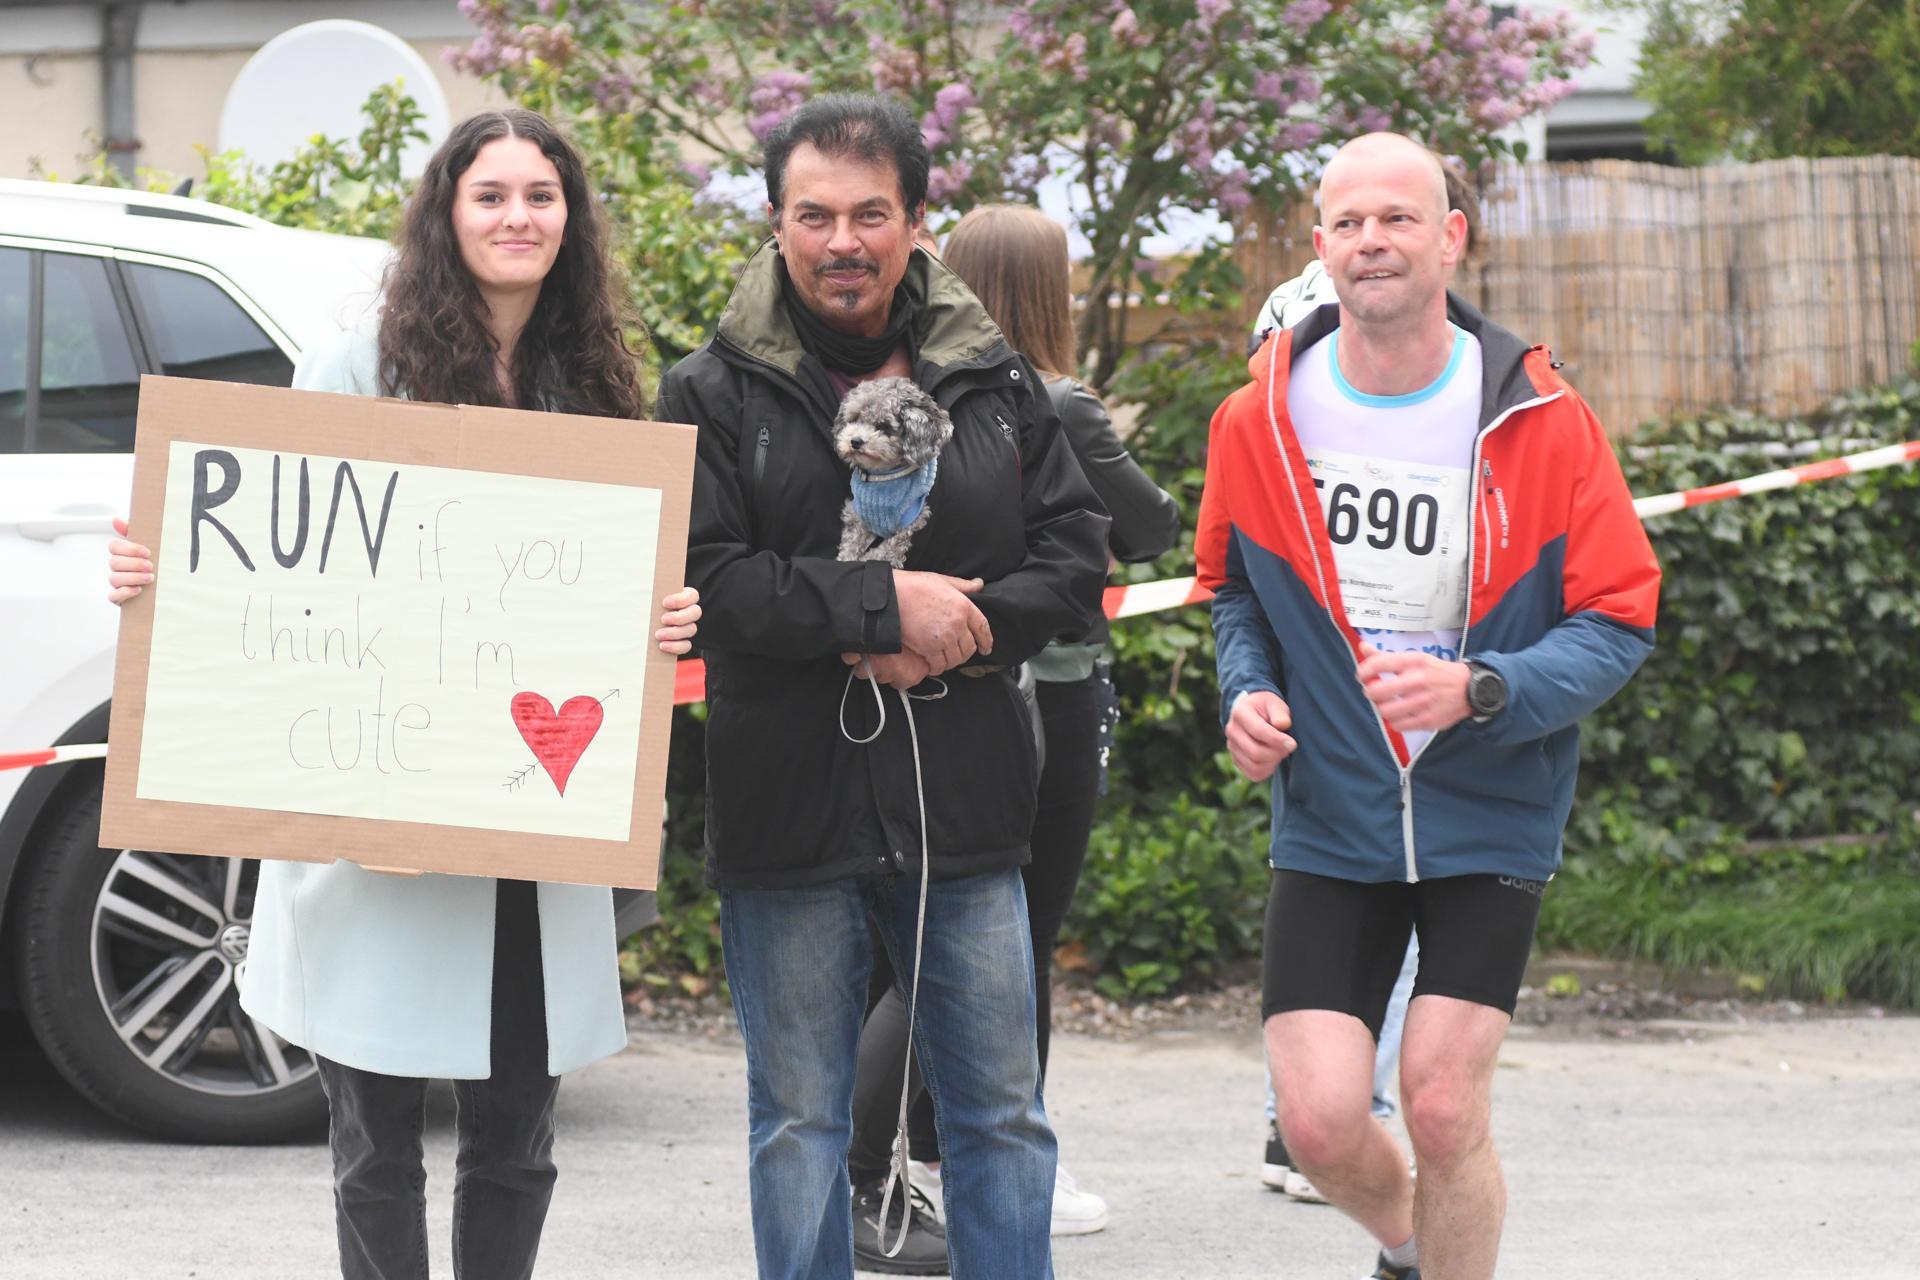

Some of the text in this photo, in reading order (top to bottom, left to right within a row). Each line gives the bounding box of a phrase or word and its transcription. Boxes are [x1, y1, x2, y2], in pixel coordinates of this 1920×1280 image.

[190, 449, 583, 611] RUN if you
[1313, 478, 1438, 556] 690
[240, 594, 520, 688] think I'm
[288, 676, 431, 774] cute
